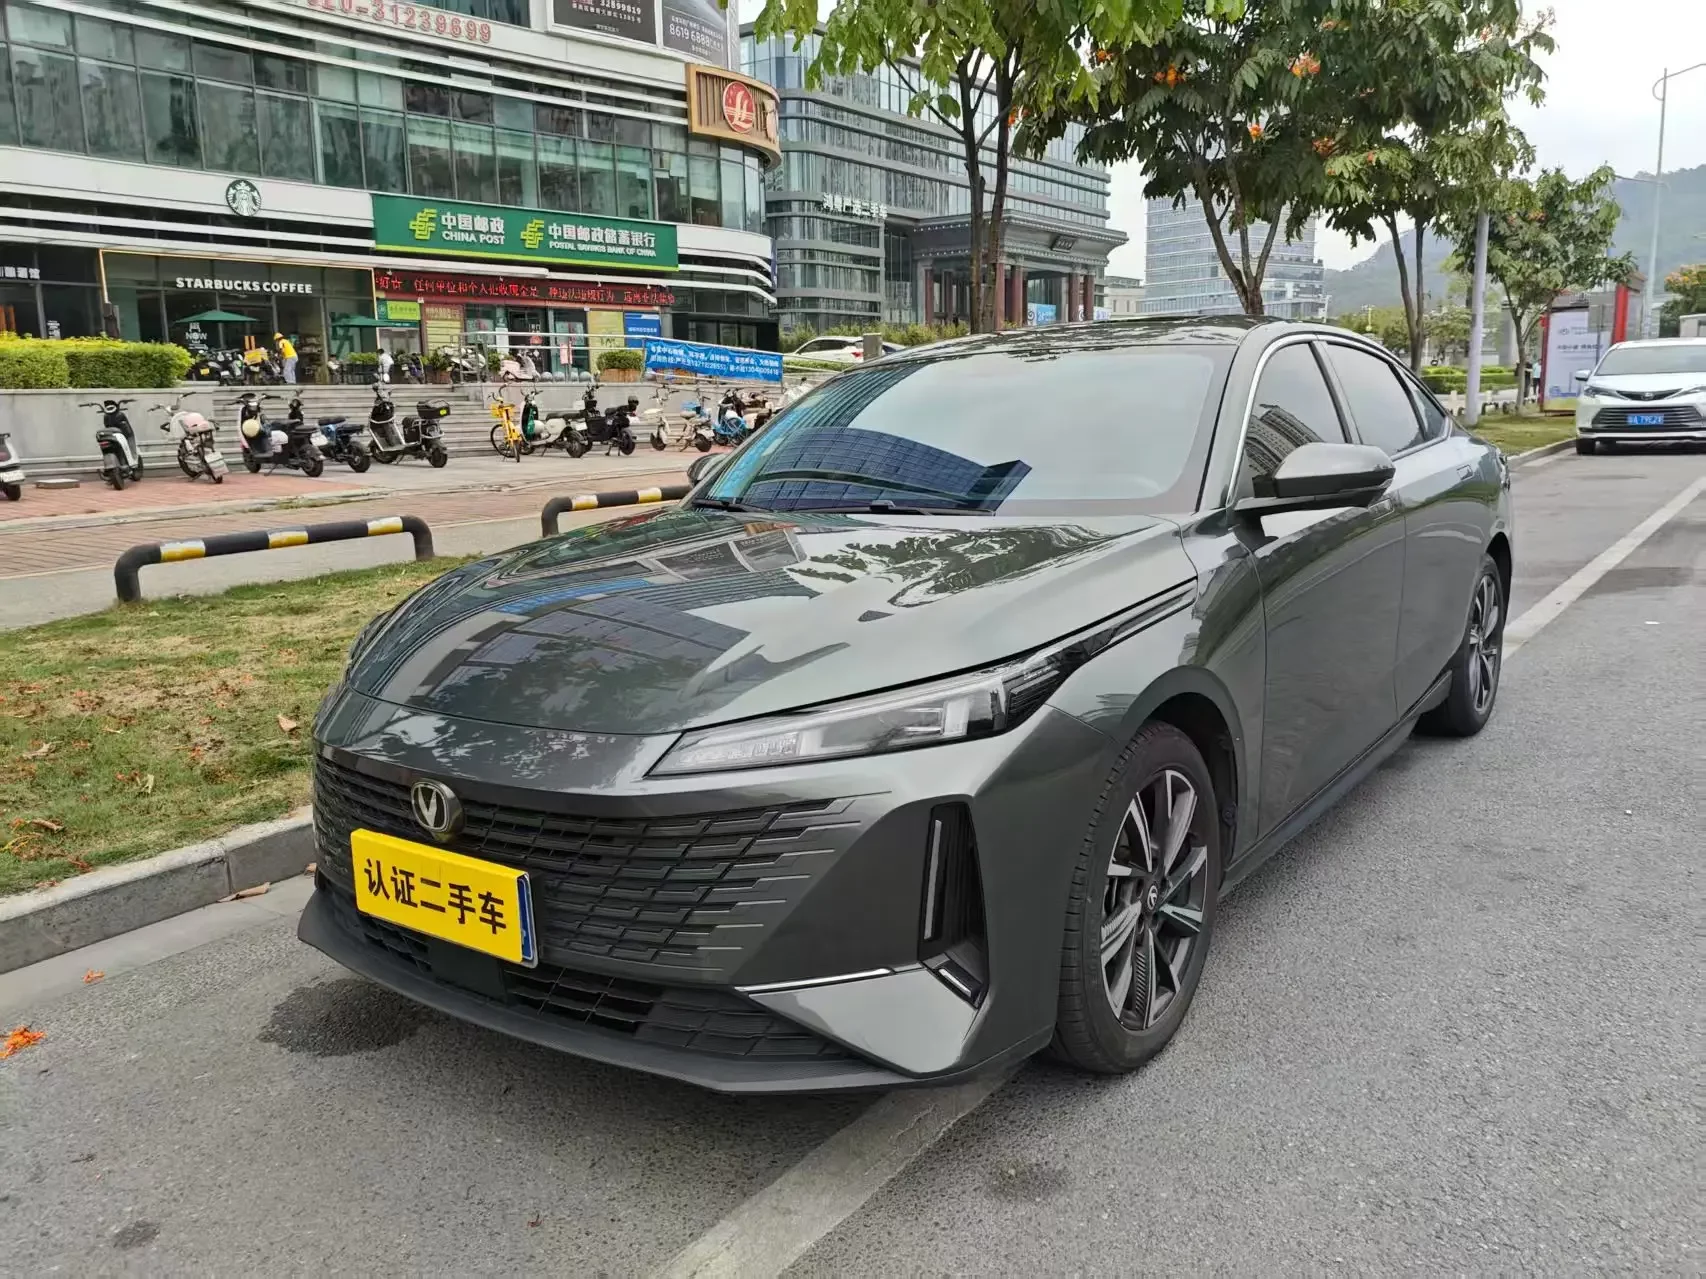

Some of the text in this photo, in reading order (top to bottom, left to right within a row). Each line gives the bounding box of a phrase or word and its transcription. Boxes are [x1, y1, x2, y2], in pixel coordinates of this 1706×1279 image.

[669, 23, 689, 40] 8619
[441, 212, 505, 234] 中国邮政
[442, 231, 505, 245] CHINA POST
[548, 223, 655, 248] 中国邮政储蓄银行
[549, 241, 576, 251] POSTAL
[607, 246, 626, 255] BANK
[627, 248, 636, 256] OF
[637, 249, 657, 258] CHINA
[176, 277, 312, 294] STARBUCKS COFFEE
[364, 858, 507, 935] 认证二手车
